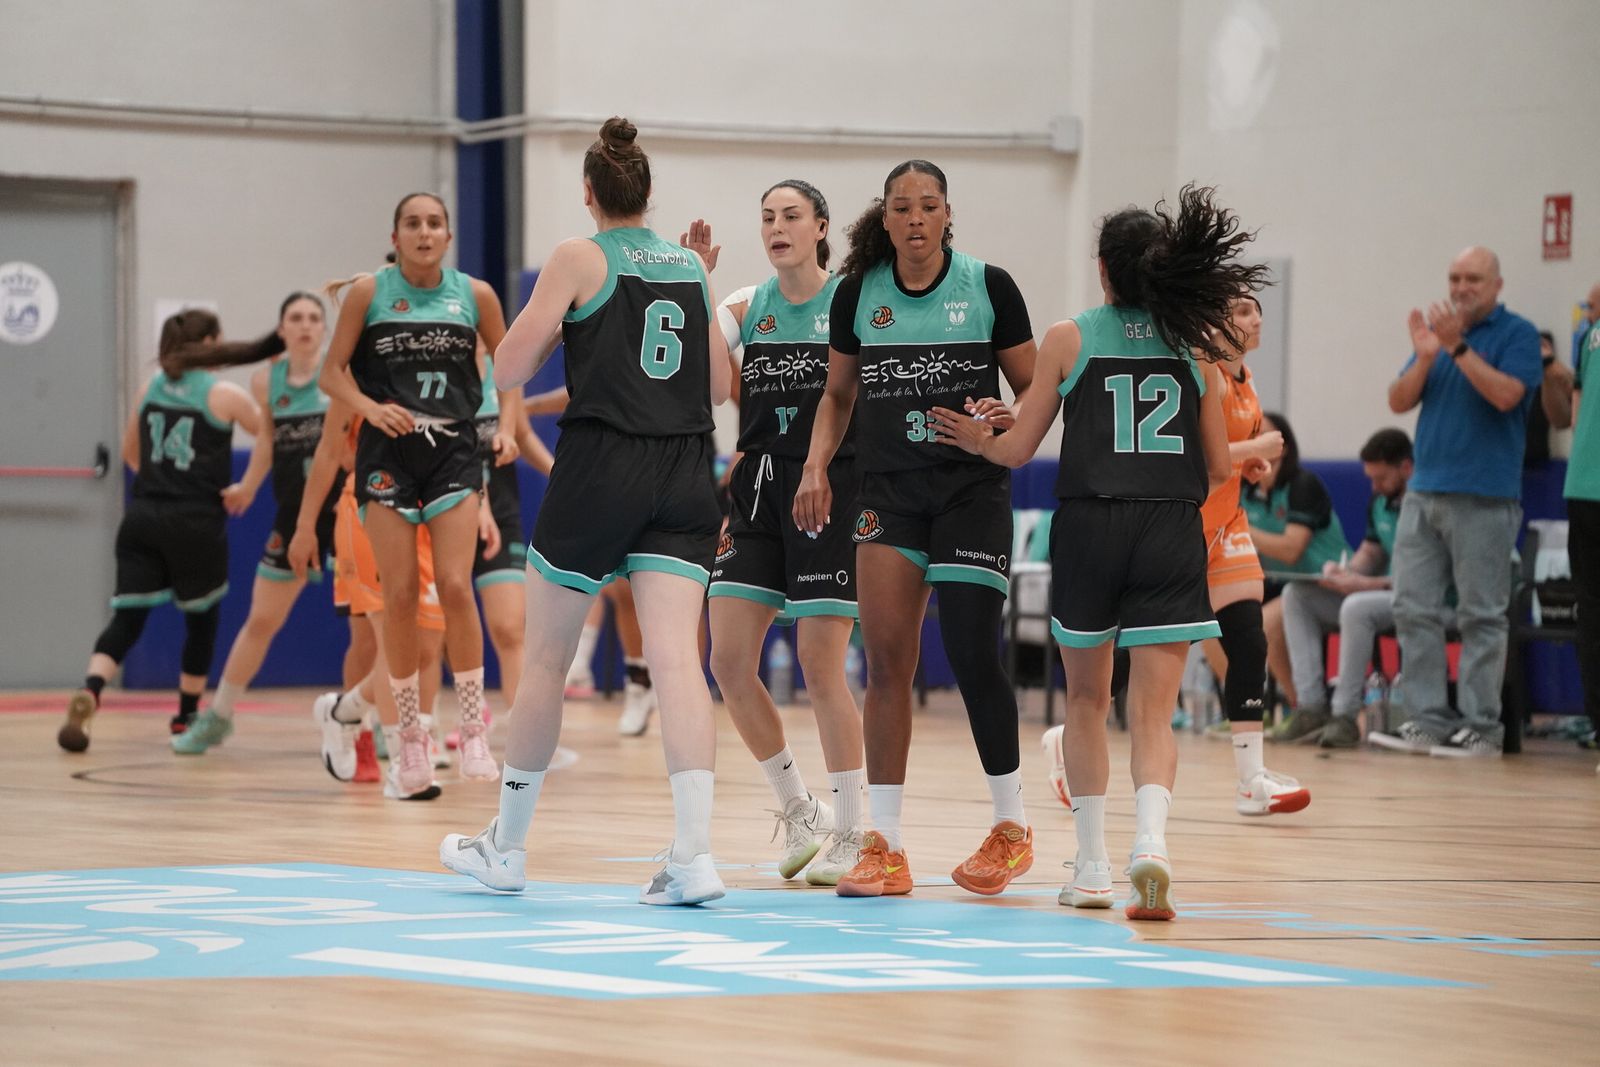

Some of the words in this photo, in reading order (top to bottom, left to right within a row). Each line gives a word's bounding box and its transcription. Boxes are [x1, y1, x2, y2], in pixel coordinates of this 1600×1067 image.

[943, 300, 969, 310] vive
[1125, 323, 1153, 338] GEA
[640, 299, 685, 380] 6
[416, 371, 448, 399] 77
[904, 386, 913, 396] la
[926, 384, 950, 395] Costa
[963, 379, 979, 389] Sol
[1105, 374, 1184, 454] 12
[147, 411, 196, 470] 14
[955, 548, 996, 562] hospiten
[797, 572, 833, 583] hospiten
